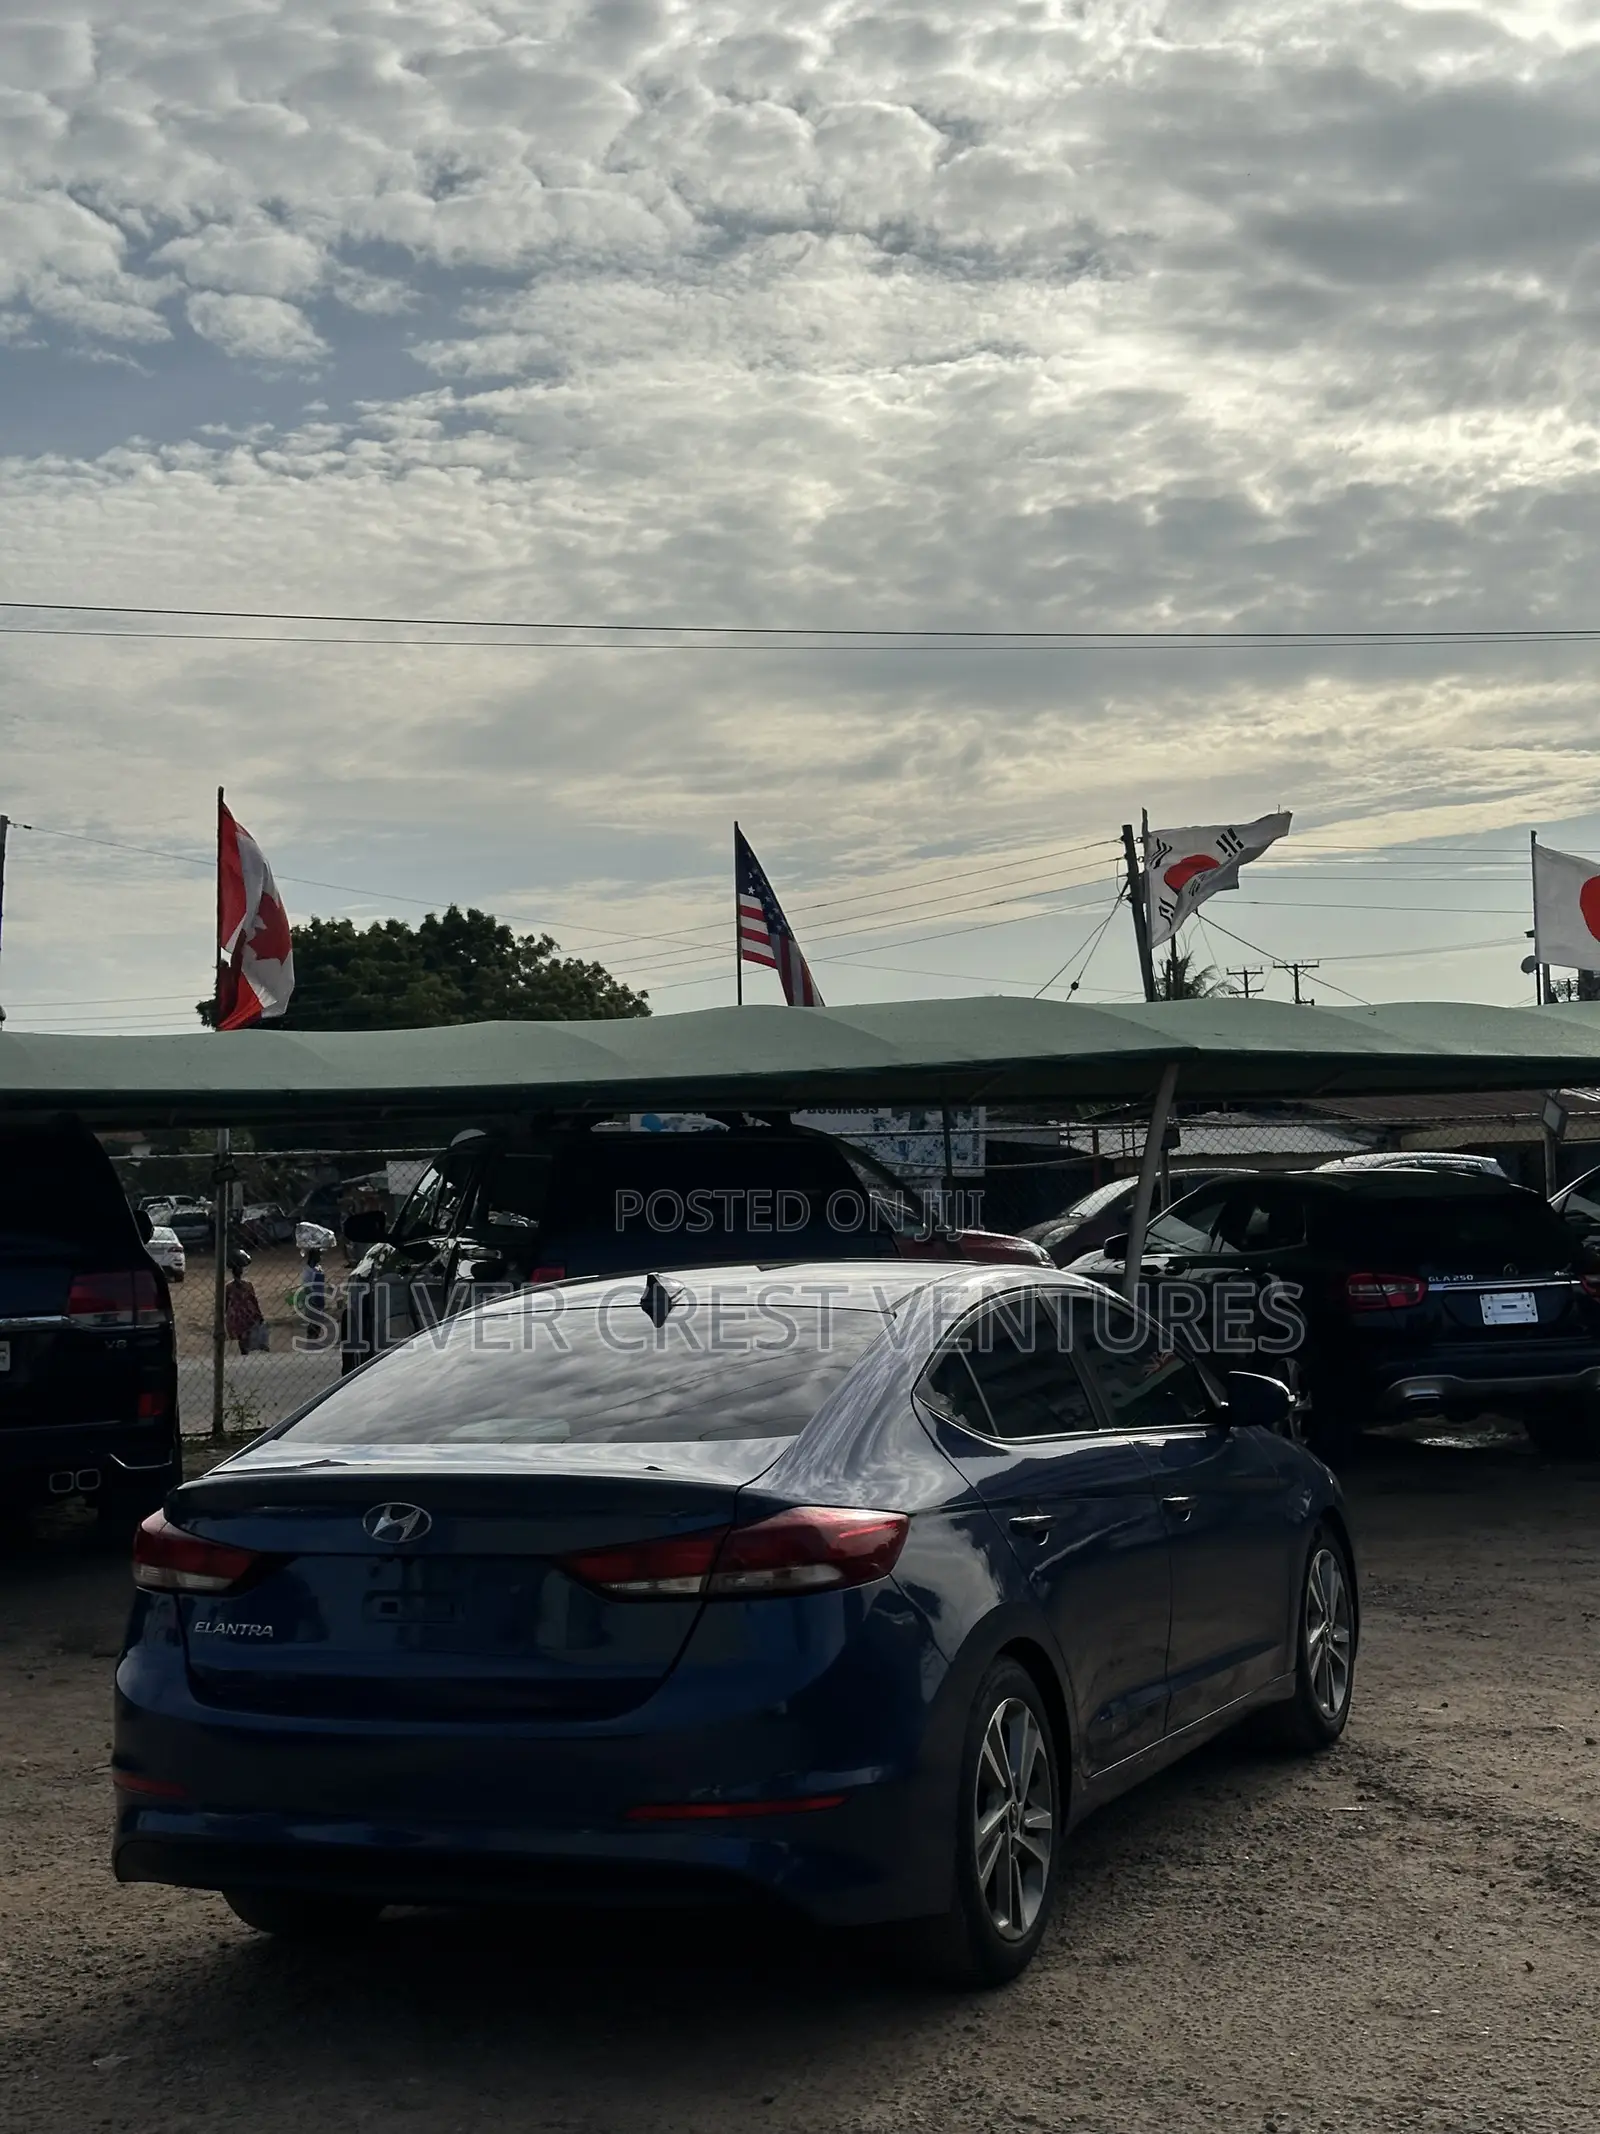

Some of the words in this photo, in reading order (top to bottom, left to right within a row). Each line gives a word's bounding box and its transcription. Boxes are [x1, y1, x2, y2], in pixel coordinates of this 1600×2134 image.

[1428, 1275, 1451, 1283] GLA
[1452, 1274, 1474, 1282] 250
[103, 1338, 129, 1350] V8
[193, 1619, 275, 1638] ELANTRA
